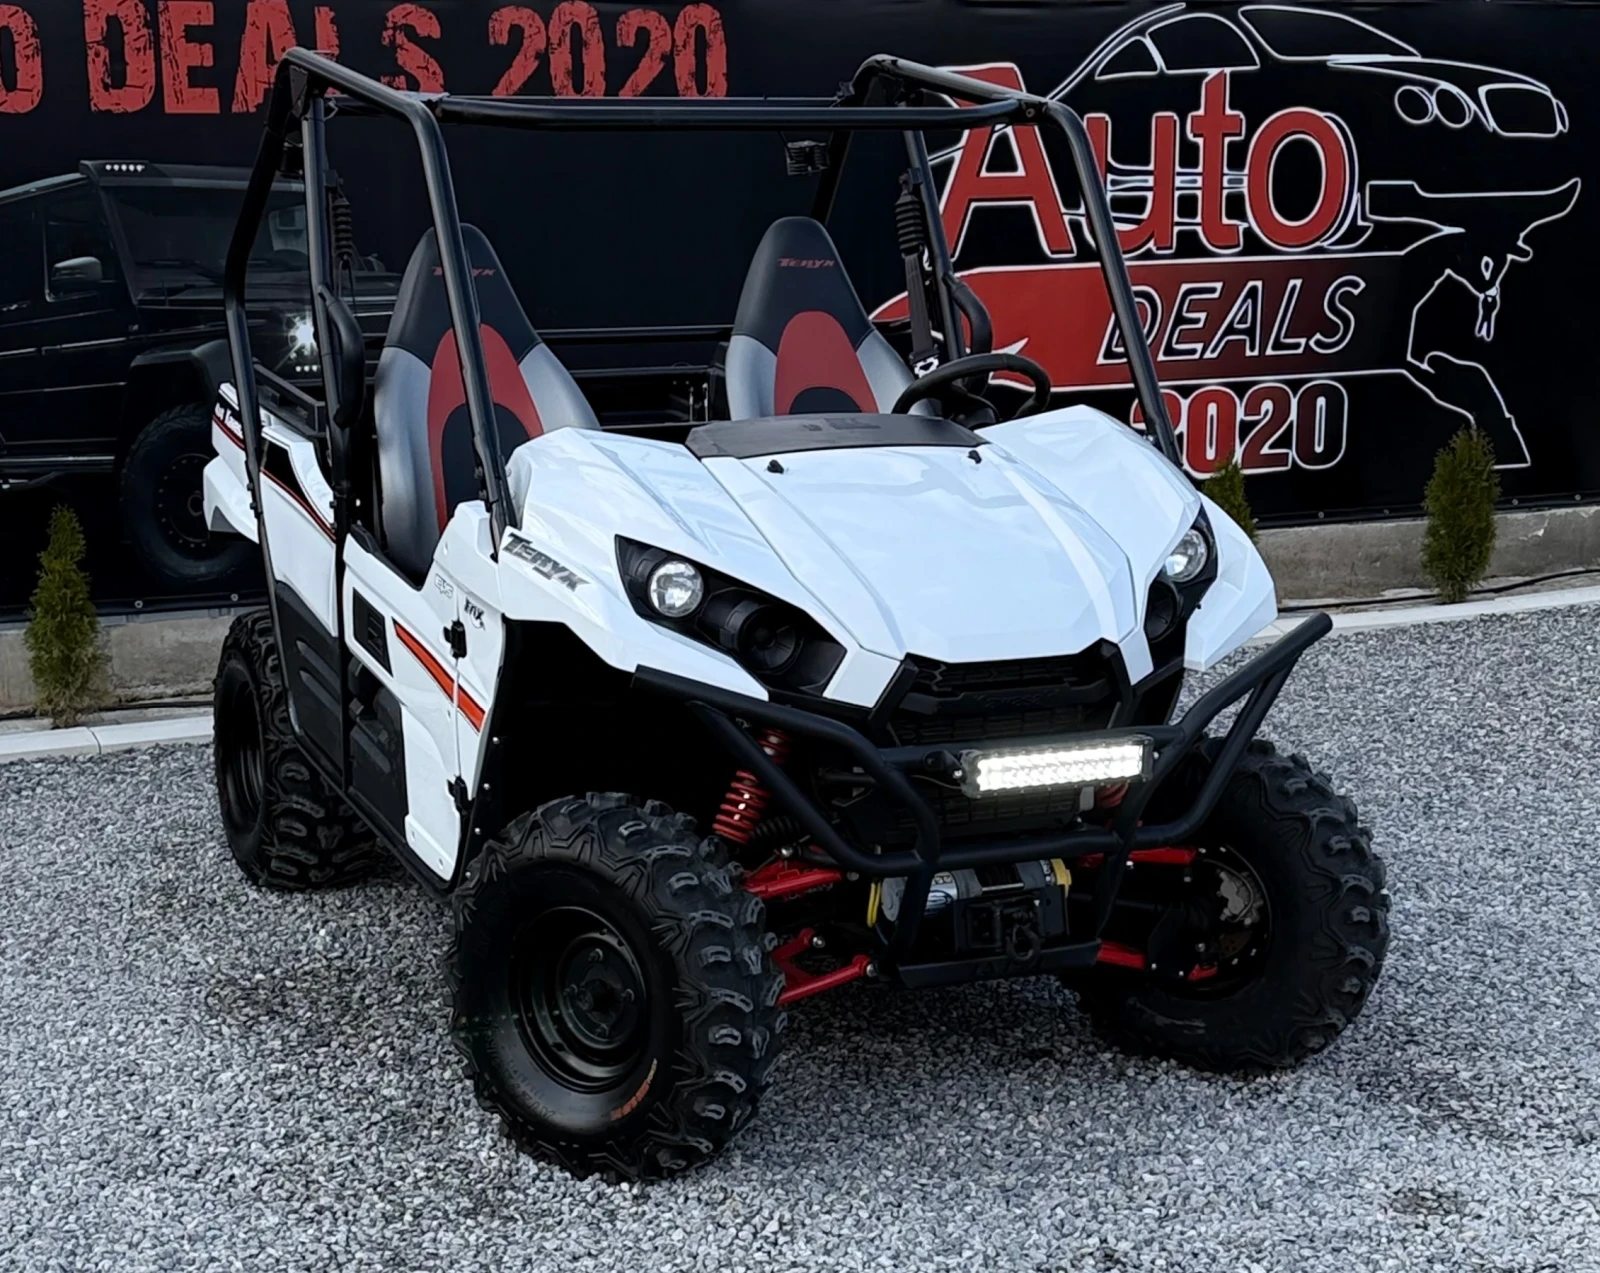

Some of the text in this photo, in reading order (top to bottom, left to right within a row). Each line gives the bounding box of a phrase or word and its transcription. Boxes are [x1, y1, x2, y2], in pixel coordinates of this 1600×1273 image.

[488, 0, 728, 97] 2020
[925, 62, 1348, 258] Auto
[1096, 275, 1366, 365] DEALS
